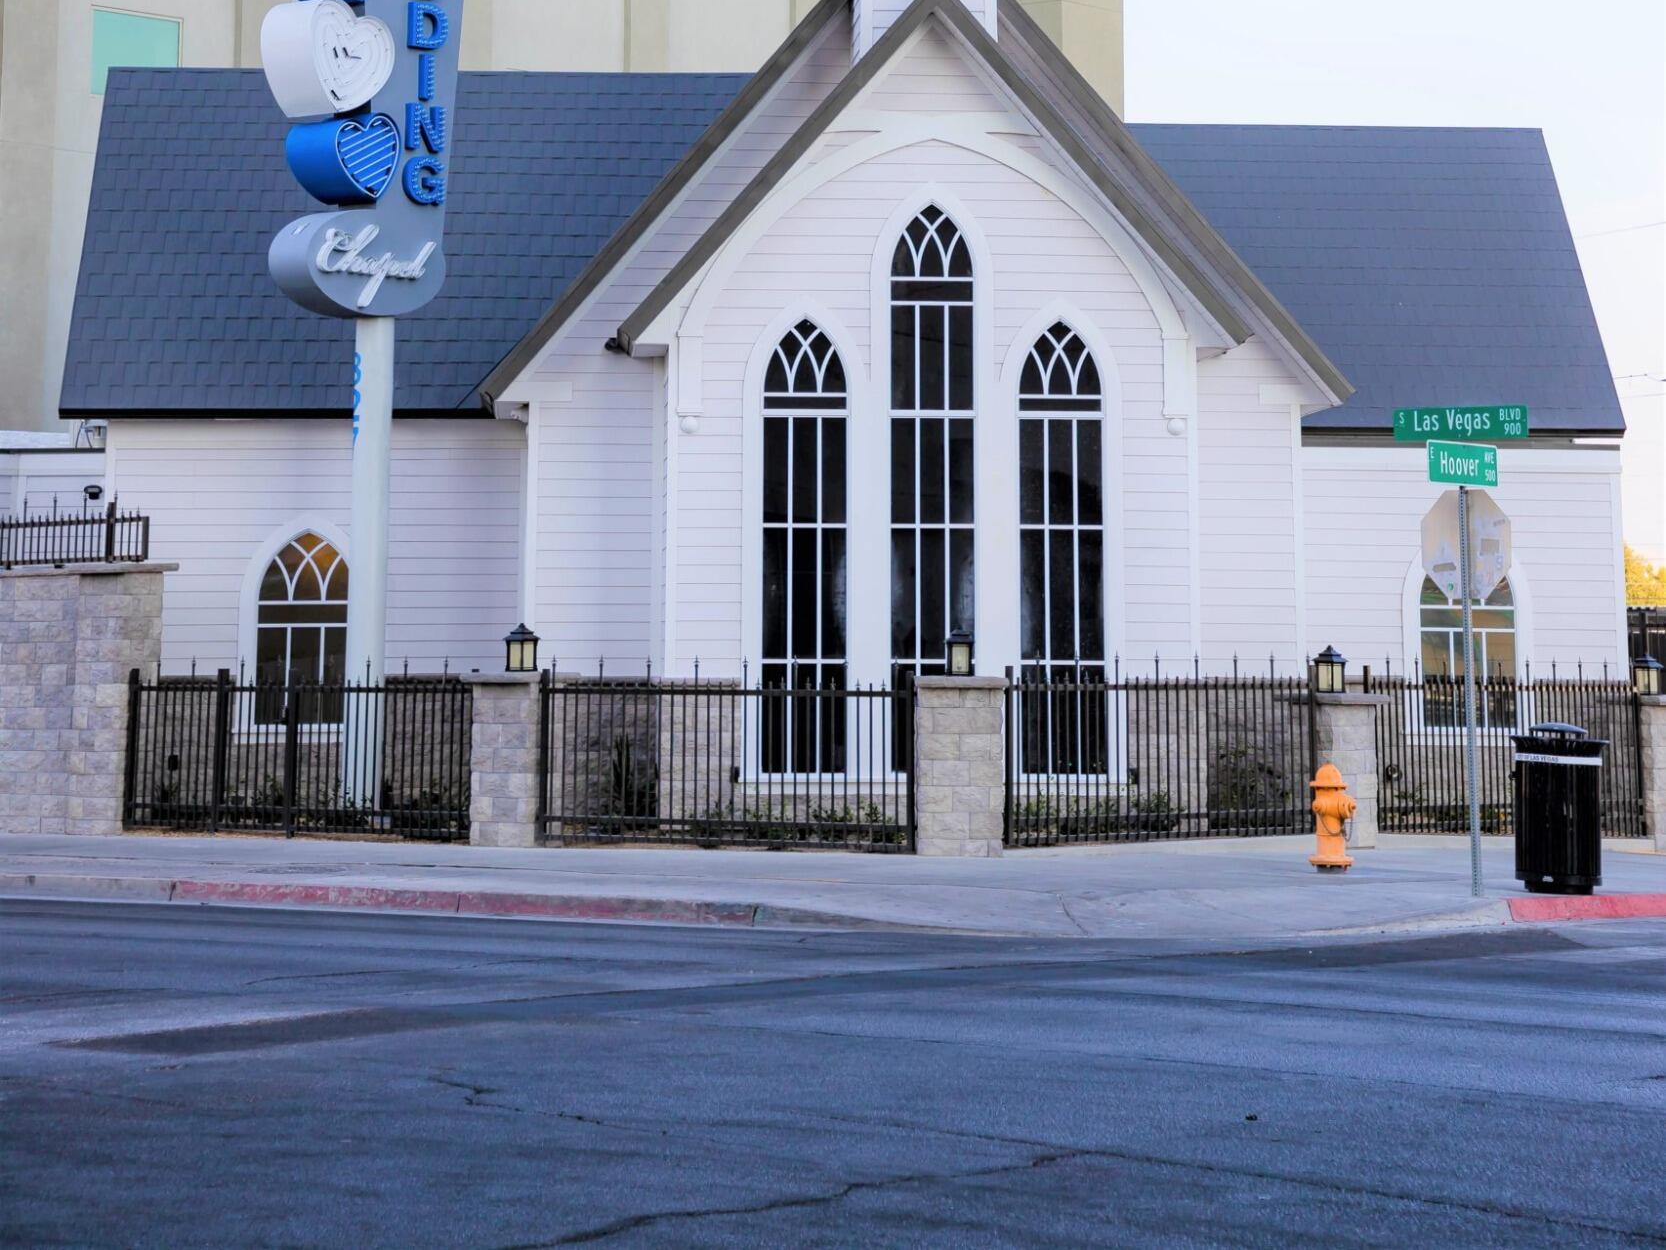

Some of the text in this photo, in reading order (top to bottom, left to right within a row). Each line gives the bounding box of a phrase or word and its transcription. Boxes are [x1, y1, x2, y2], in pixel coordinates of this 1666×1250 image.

[316, 224, 437, 308] Chapel
[1399, 408, 1521, 437] S Las Vegas BLVD
[1504, 423, 1521, 435] 900
[1430, 447, 1495, 477] E Hoover AVE
[1485, 470, 1496, 482] 500
